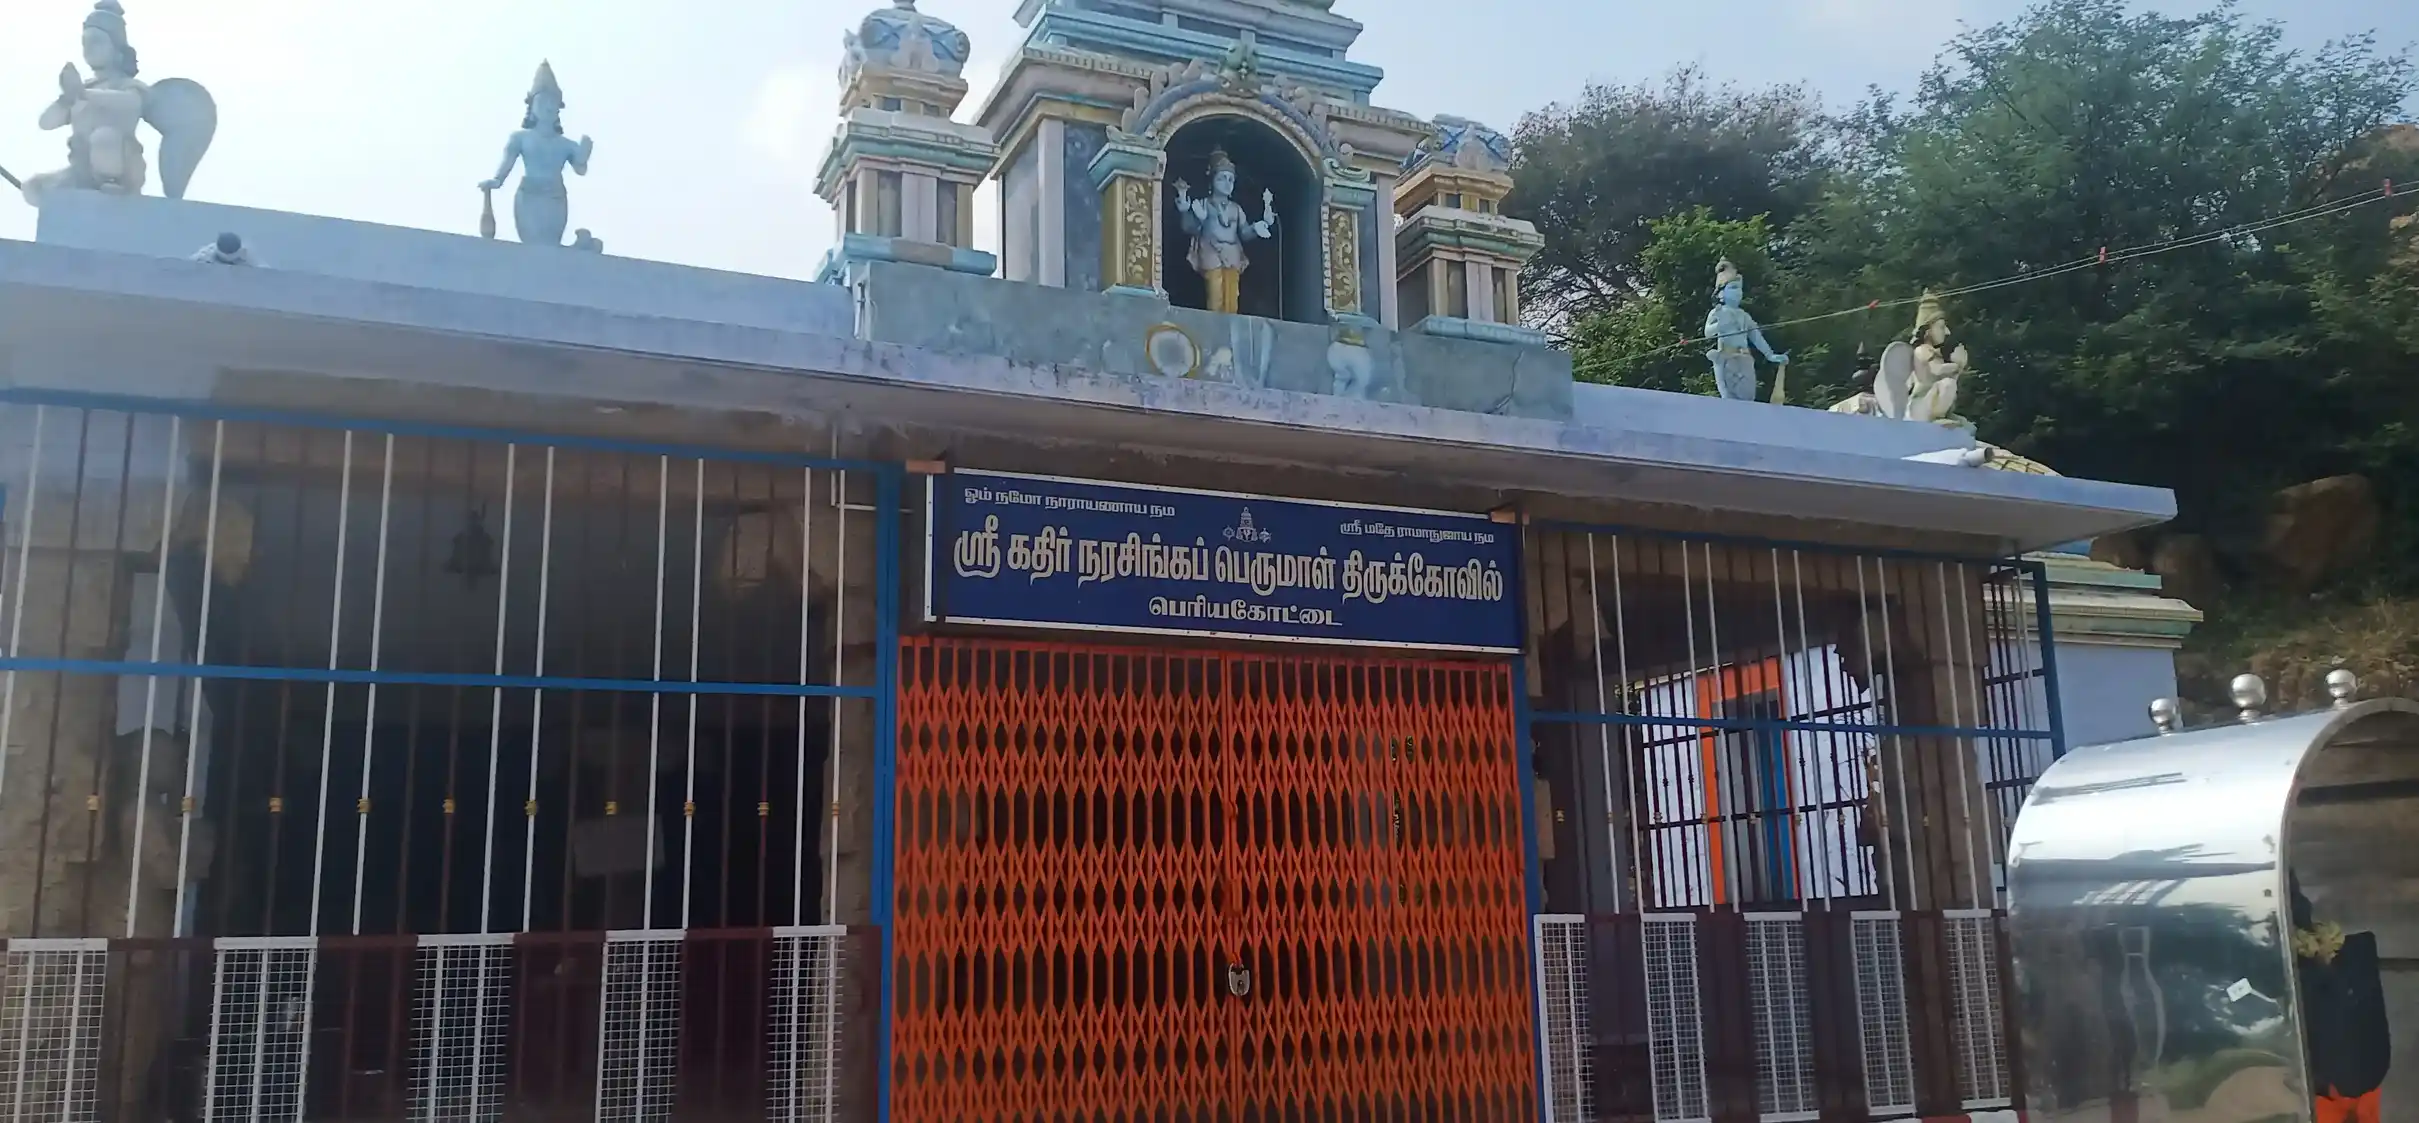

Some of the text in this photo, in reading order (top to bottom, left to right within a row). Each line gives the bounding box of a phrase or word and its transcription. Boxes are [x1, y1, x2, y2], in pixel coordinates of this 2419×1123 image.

[995, 490, 1042, 505] நமோ
[1045, 496, 1148, 514] நாராயணாய
[1149, 504, 1176, 518] நம
[1340, 519, 1363, 536] ஸ்ரீ
[1364, 522, 1396, 538] மதே
[1473, 533, 1495, 545] நம
[953, 514, 1504, 605] ஸ்ரீ கதிர் நரசிங்கப் பெருமாள் திருக்கோவில்
[1149, 594, 1344, 627] பெரியகோட்டை
